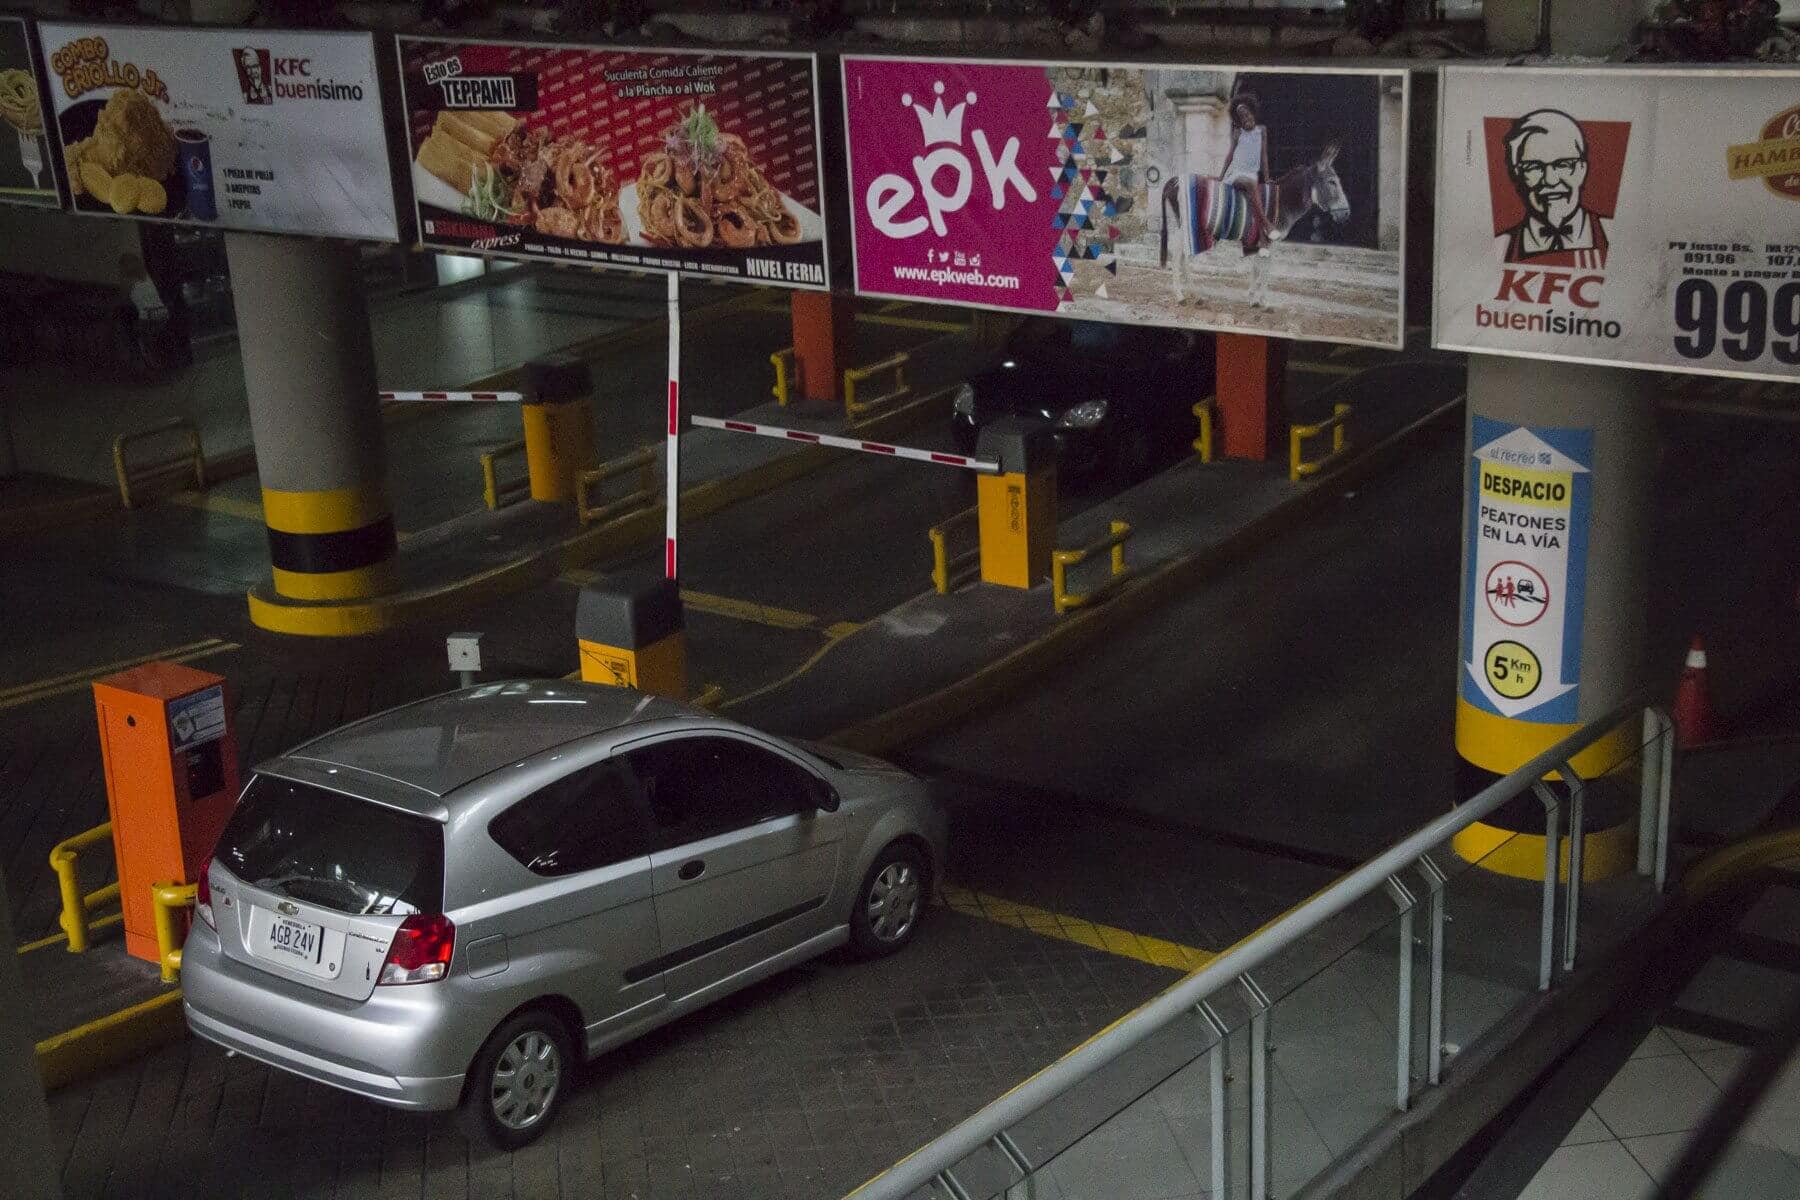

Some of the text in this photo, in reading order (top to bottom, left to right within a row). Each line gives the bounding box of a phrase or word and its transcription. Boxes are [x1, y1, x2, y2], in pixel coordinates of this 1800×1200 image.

[52, 36, 109, 75] COMBO
[274, 58, 312, 76] KFC
[63, 61, 140, 98] CRIOLLO
[425, 58, 461, 81] Esto es
[603, 64, 724, 82] Suculenta Comida Caliente
[274, 79, 363, 101] buenísimo
[441, 78, 515, 105] TEPPAN!!
[618, 81, 716, 98] a la Plancha o al Wok
[865, 128, 1038, 240] epk
[470, 232, 522, 249] express
[1690, 242, 1729, 252] Justo
[746, 257, 824, 284] NIVEL FERIA
[893, 266, 1020, 289] www.epkweb.com
[1494, 269, 1605, 309] KFC
[1475, 304, 1622, 339] buenísimo
[1489, 447, 1536, 464] el recreo
[1484, 472, 1566, 501] DESPACIO
[1481, 505, 1566, 531] PEATONES
[1482, 524, 1560, 549] EN LA VÍA
[1493, 655, 1531, 680] 5 Km
[1516, 674, 1524, 684] h
[270, 923, 291, 945] AGB
[293, 930, 315, 953] 24V
